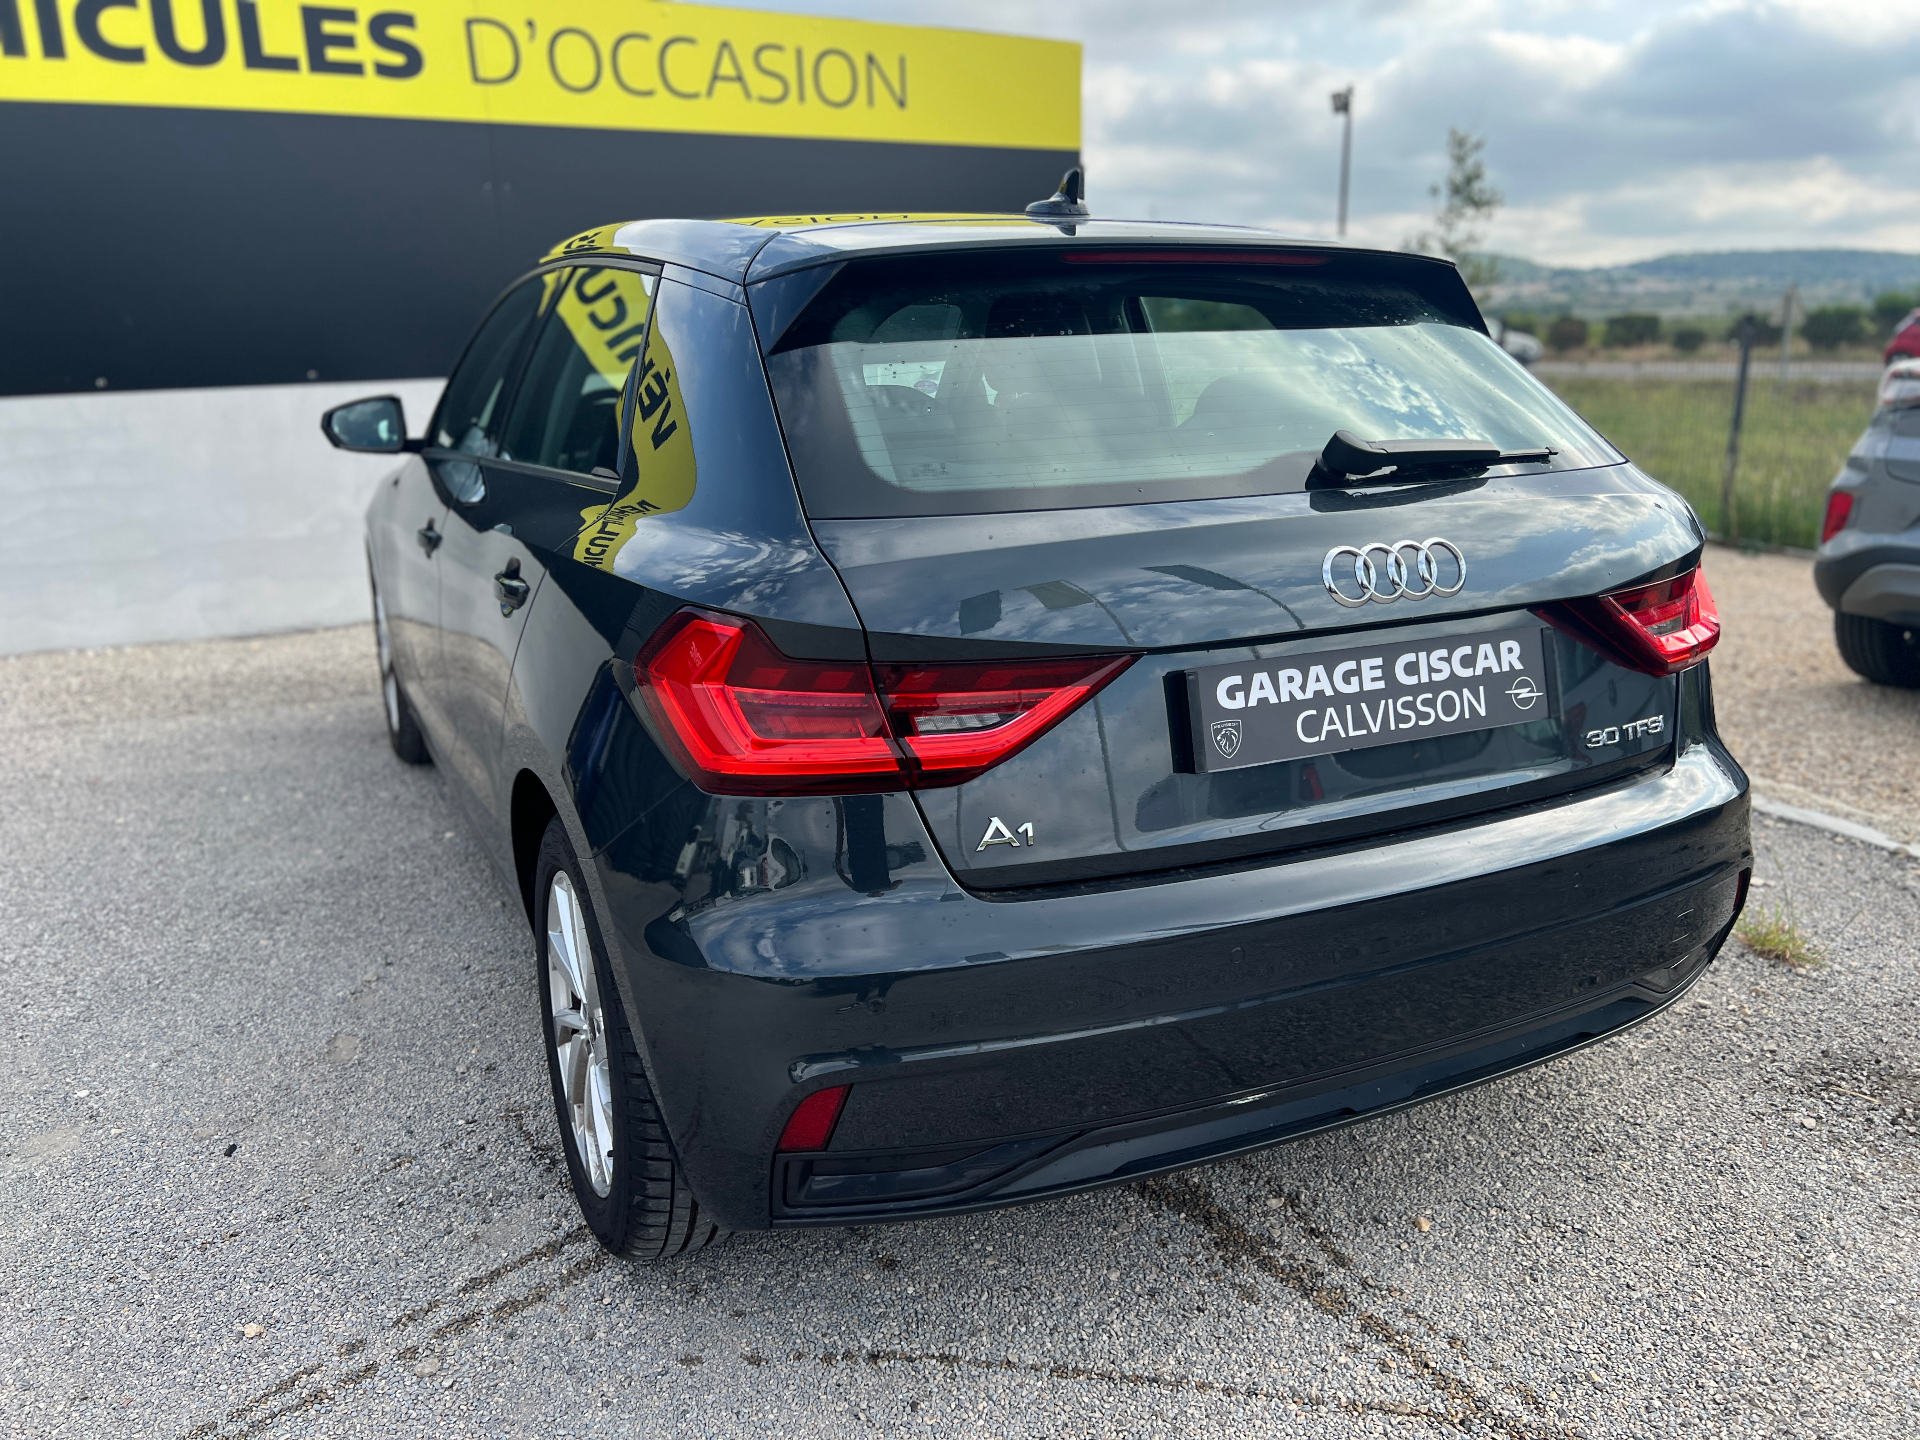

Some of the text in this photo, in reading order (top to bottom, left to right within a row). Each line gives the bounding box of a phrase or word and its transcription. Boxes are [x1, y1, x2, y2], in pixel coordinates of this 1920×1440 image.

[1216, 640, 1524, 710] GARAGE CISCAR
[1296, 686, 1487, 743] CALVISSON
[1585, 726, 1620, 748] 30
[975, 816, 1034, 851] A1
